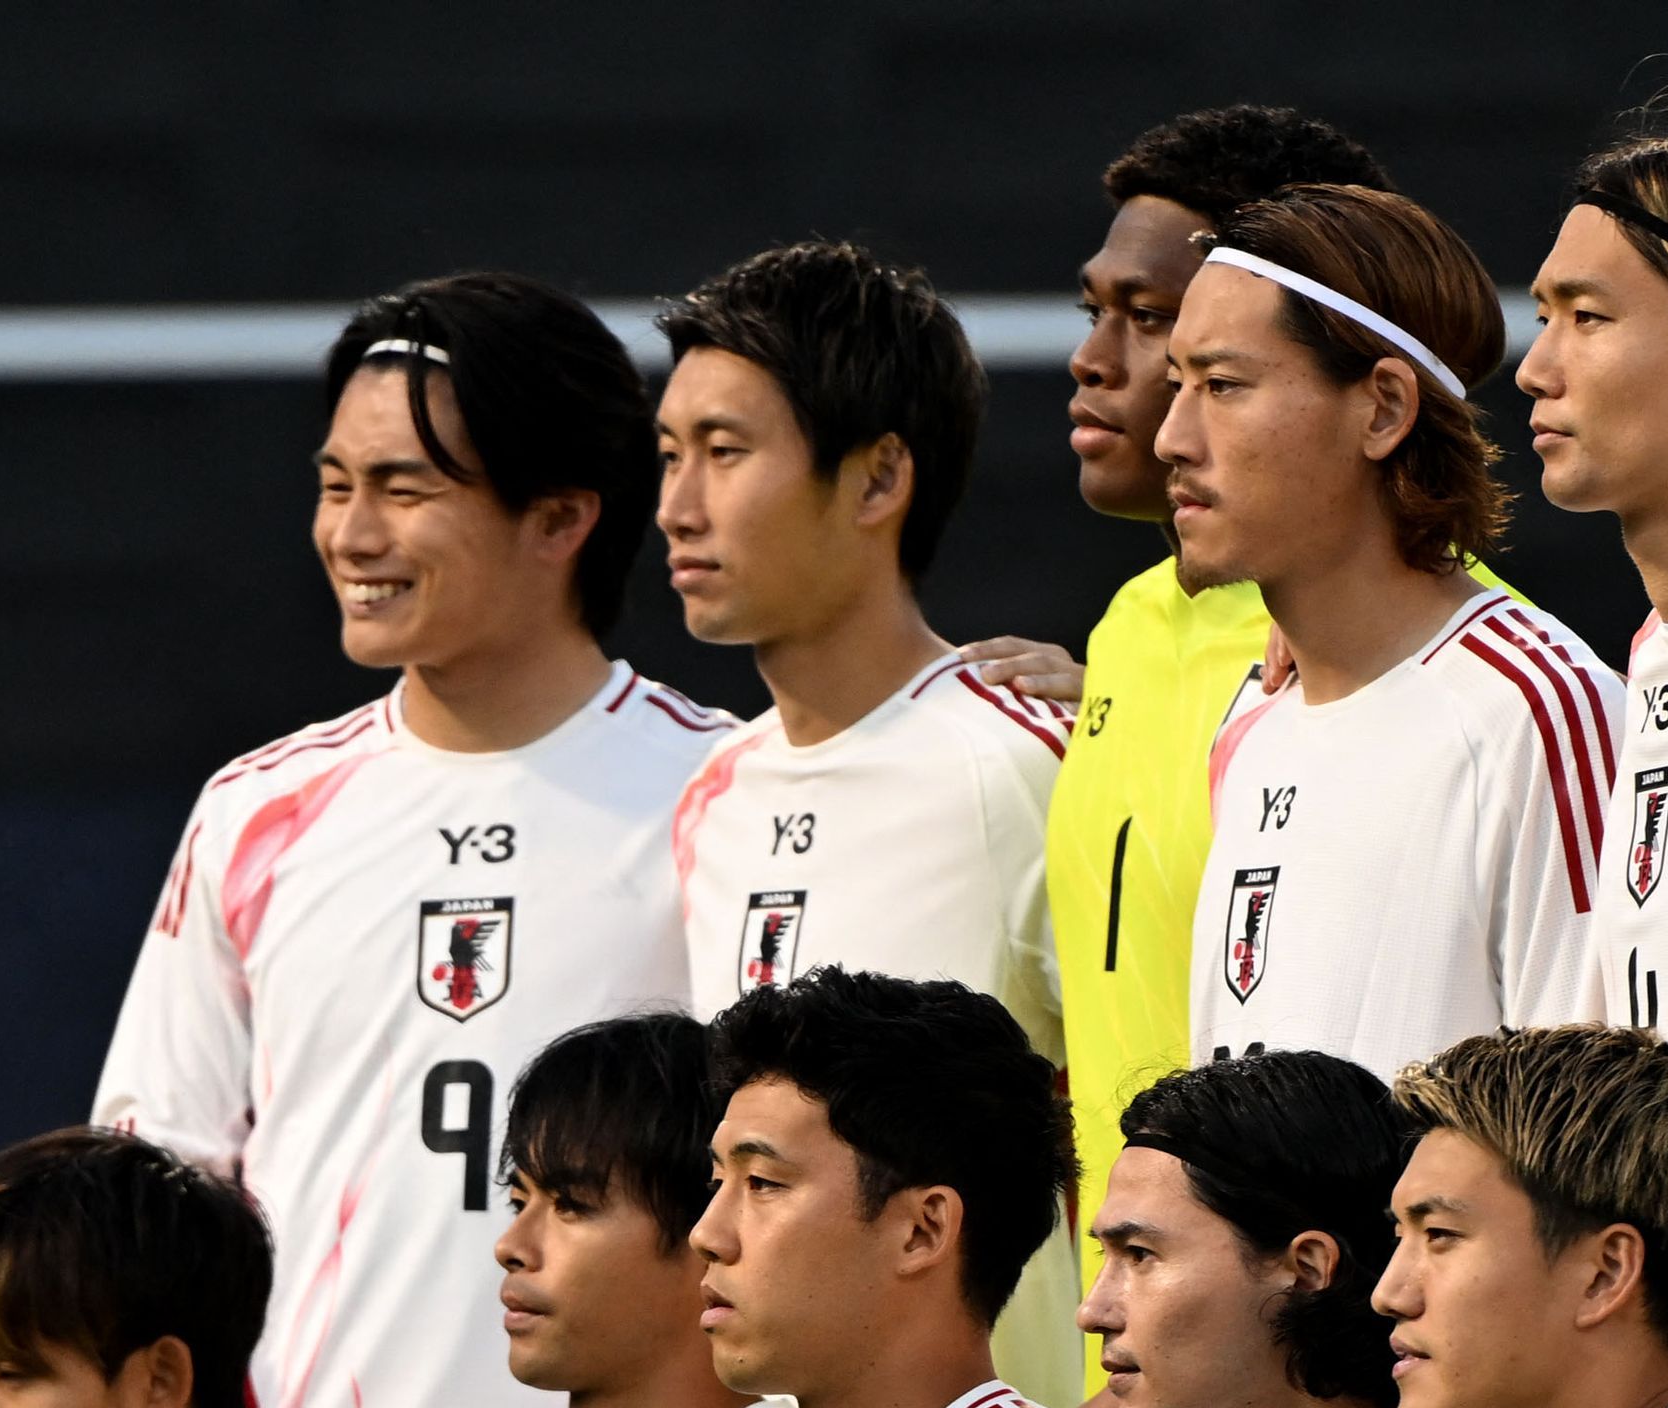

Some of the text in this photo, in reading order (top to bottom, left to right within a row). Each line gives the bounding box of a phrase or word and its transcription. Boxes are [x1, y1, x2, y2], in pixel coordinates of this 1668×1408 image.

[1259, 785, 1296, 832] Y-3
[439, 824, 516, 864] Y-3
[770, 813, 816, 856] Y-3
[1104, 816, 1132, 972] 1
[1244, 870, 1273, 883] JAPAN
[440, 899, 495, 913] JAPAN
[422, 1060, 494, 1211] 9
